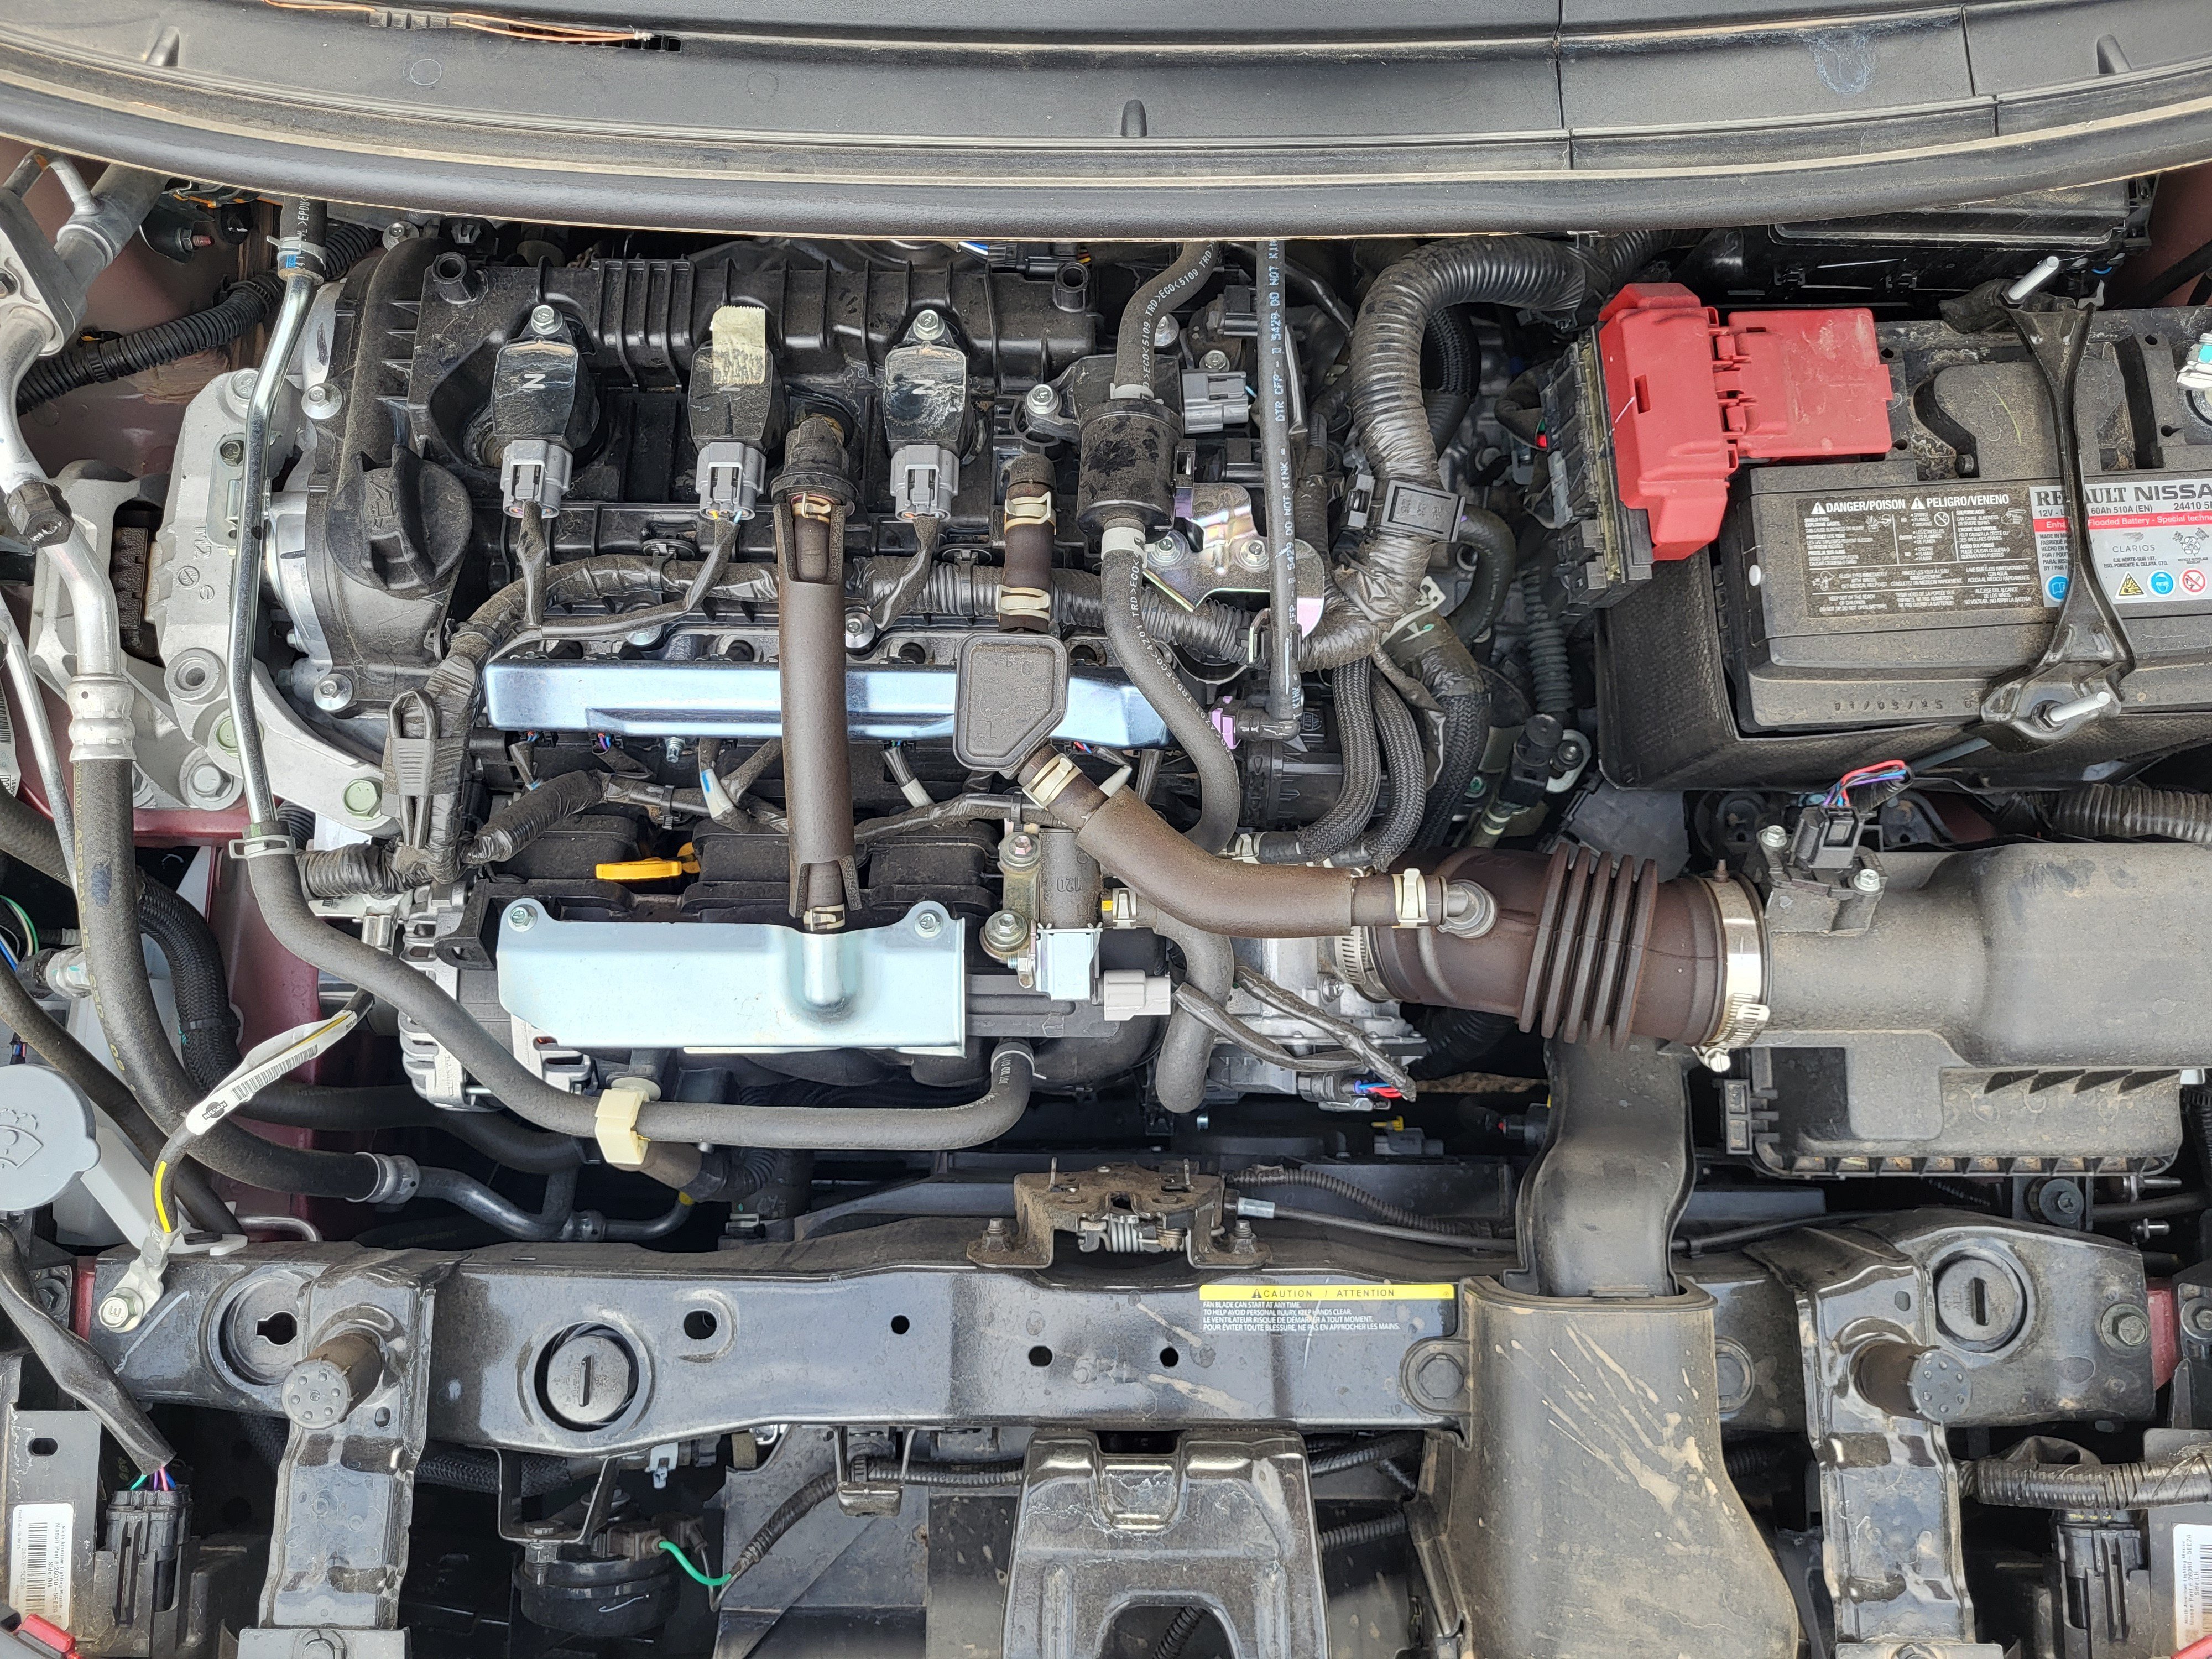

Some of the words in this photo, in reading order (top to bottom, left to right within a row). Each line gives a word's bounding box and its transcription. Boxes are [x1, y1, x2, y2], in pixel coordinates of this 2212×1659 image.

[1267, 240, 1279, 259] KIN
[1268, 265, 1280, 286] NOT
[1269, 292, 1280, 306] DO
[1926, 494, 2010, 508] PELIGRO/VENENO
[2034, 487, 2126, 507] REULT
[2134, 483, 2212, 502] NISSA
[1282, 495, 1291, 515] NOT
[1825, 499, 1906, 513] DANGER/POISON
[2091, 506, 2112, 514] 60Ah
[2114, 505, 2134, 513] 510A
[2136, 504, 2153, 513] (EN)
[2173, 501, 2201, 510] 24410
[2088, 518, 2120, 526] Flooded
[2122, 517, 2150, 526] Battery
[2157, 515, 2185, 524] Special
[1285, 521, 1293, 536] DO
[2112, 544, 2155, 553] CLARIOS
[203, 1101, 228, 1119] NISSAN
[1337, 1289, 1395, 1297] ATTENTION
[1321, 1314, 1327, 1323] À
[1222, 1322, 1243, 1331] ÉVITER
